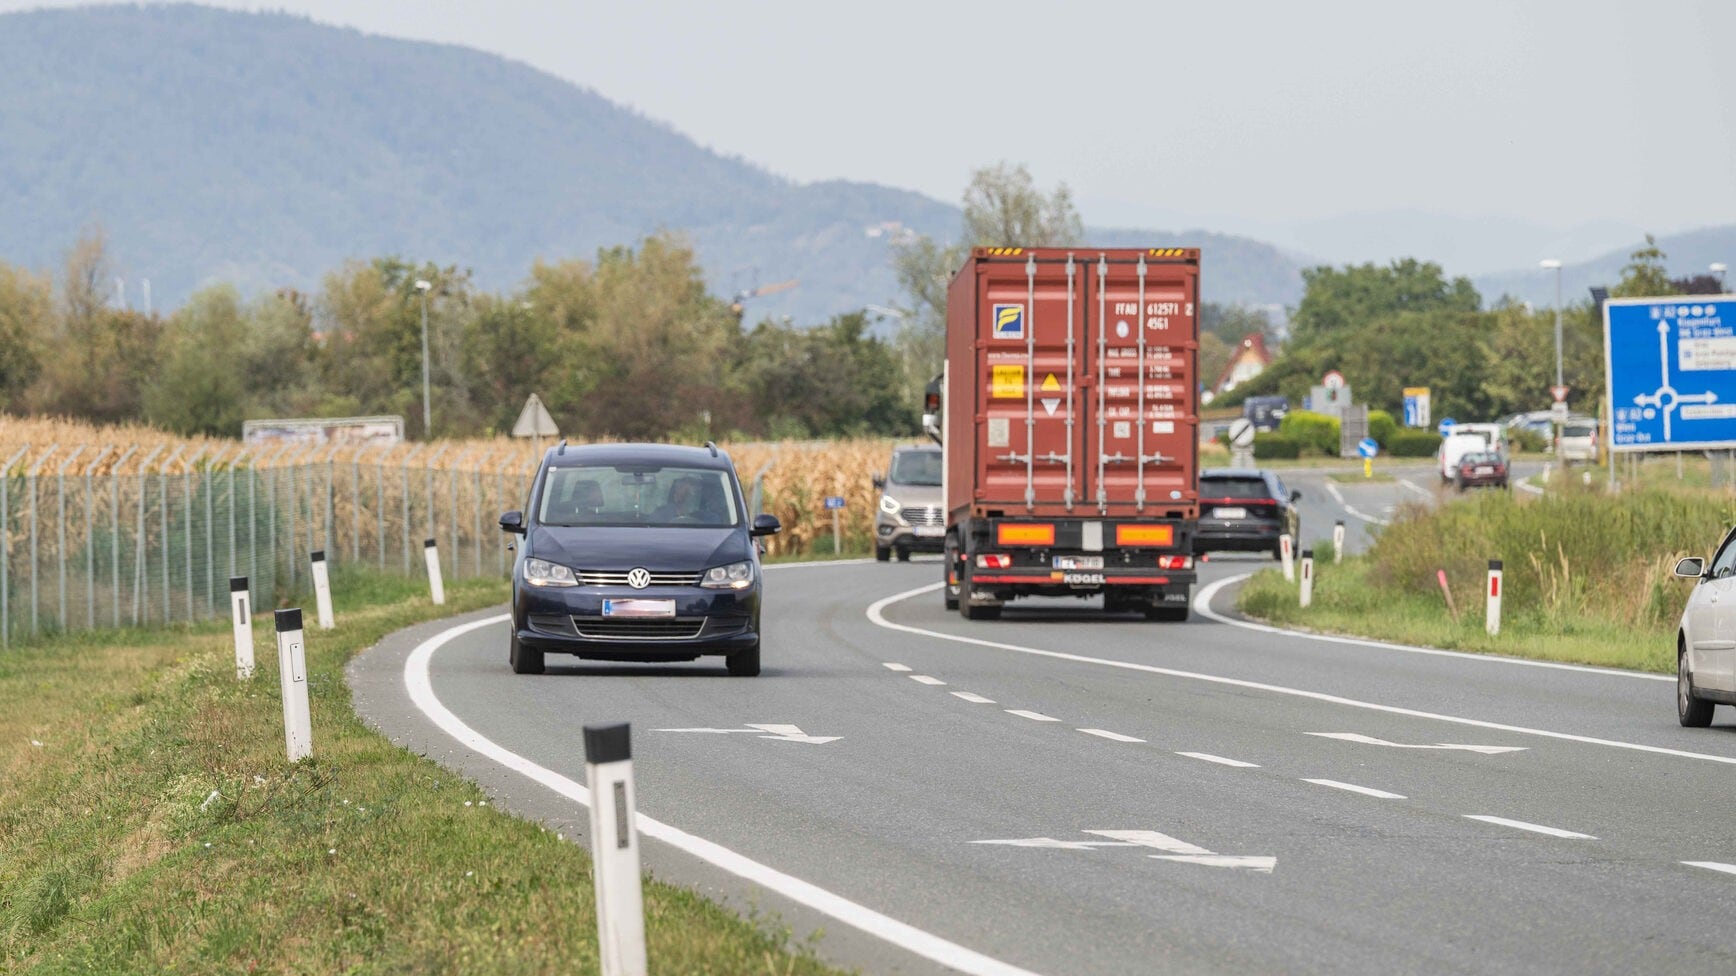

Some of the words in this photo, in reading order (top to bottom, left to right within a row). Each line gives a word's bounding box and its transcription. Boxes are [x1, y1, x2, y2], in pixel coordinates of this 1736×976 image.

[1115, 302, 1138, 316] FFAU
[1147, 302, 1179, 316] 612571
[1184, 302, 1193, 317] 2
